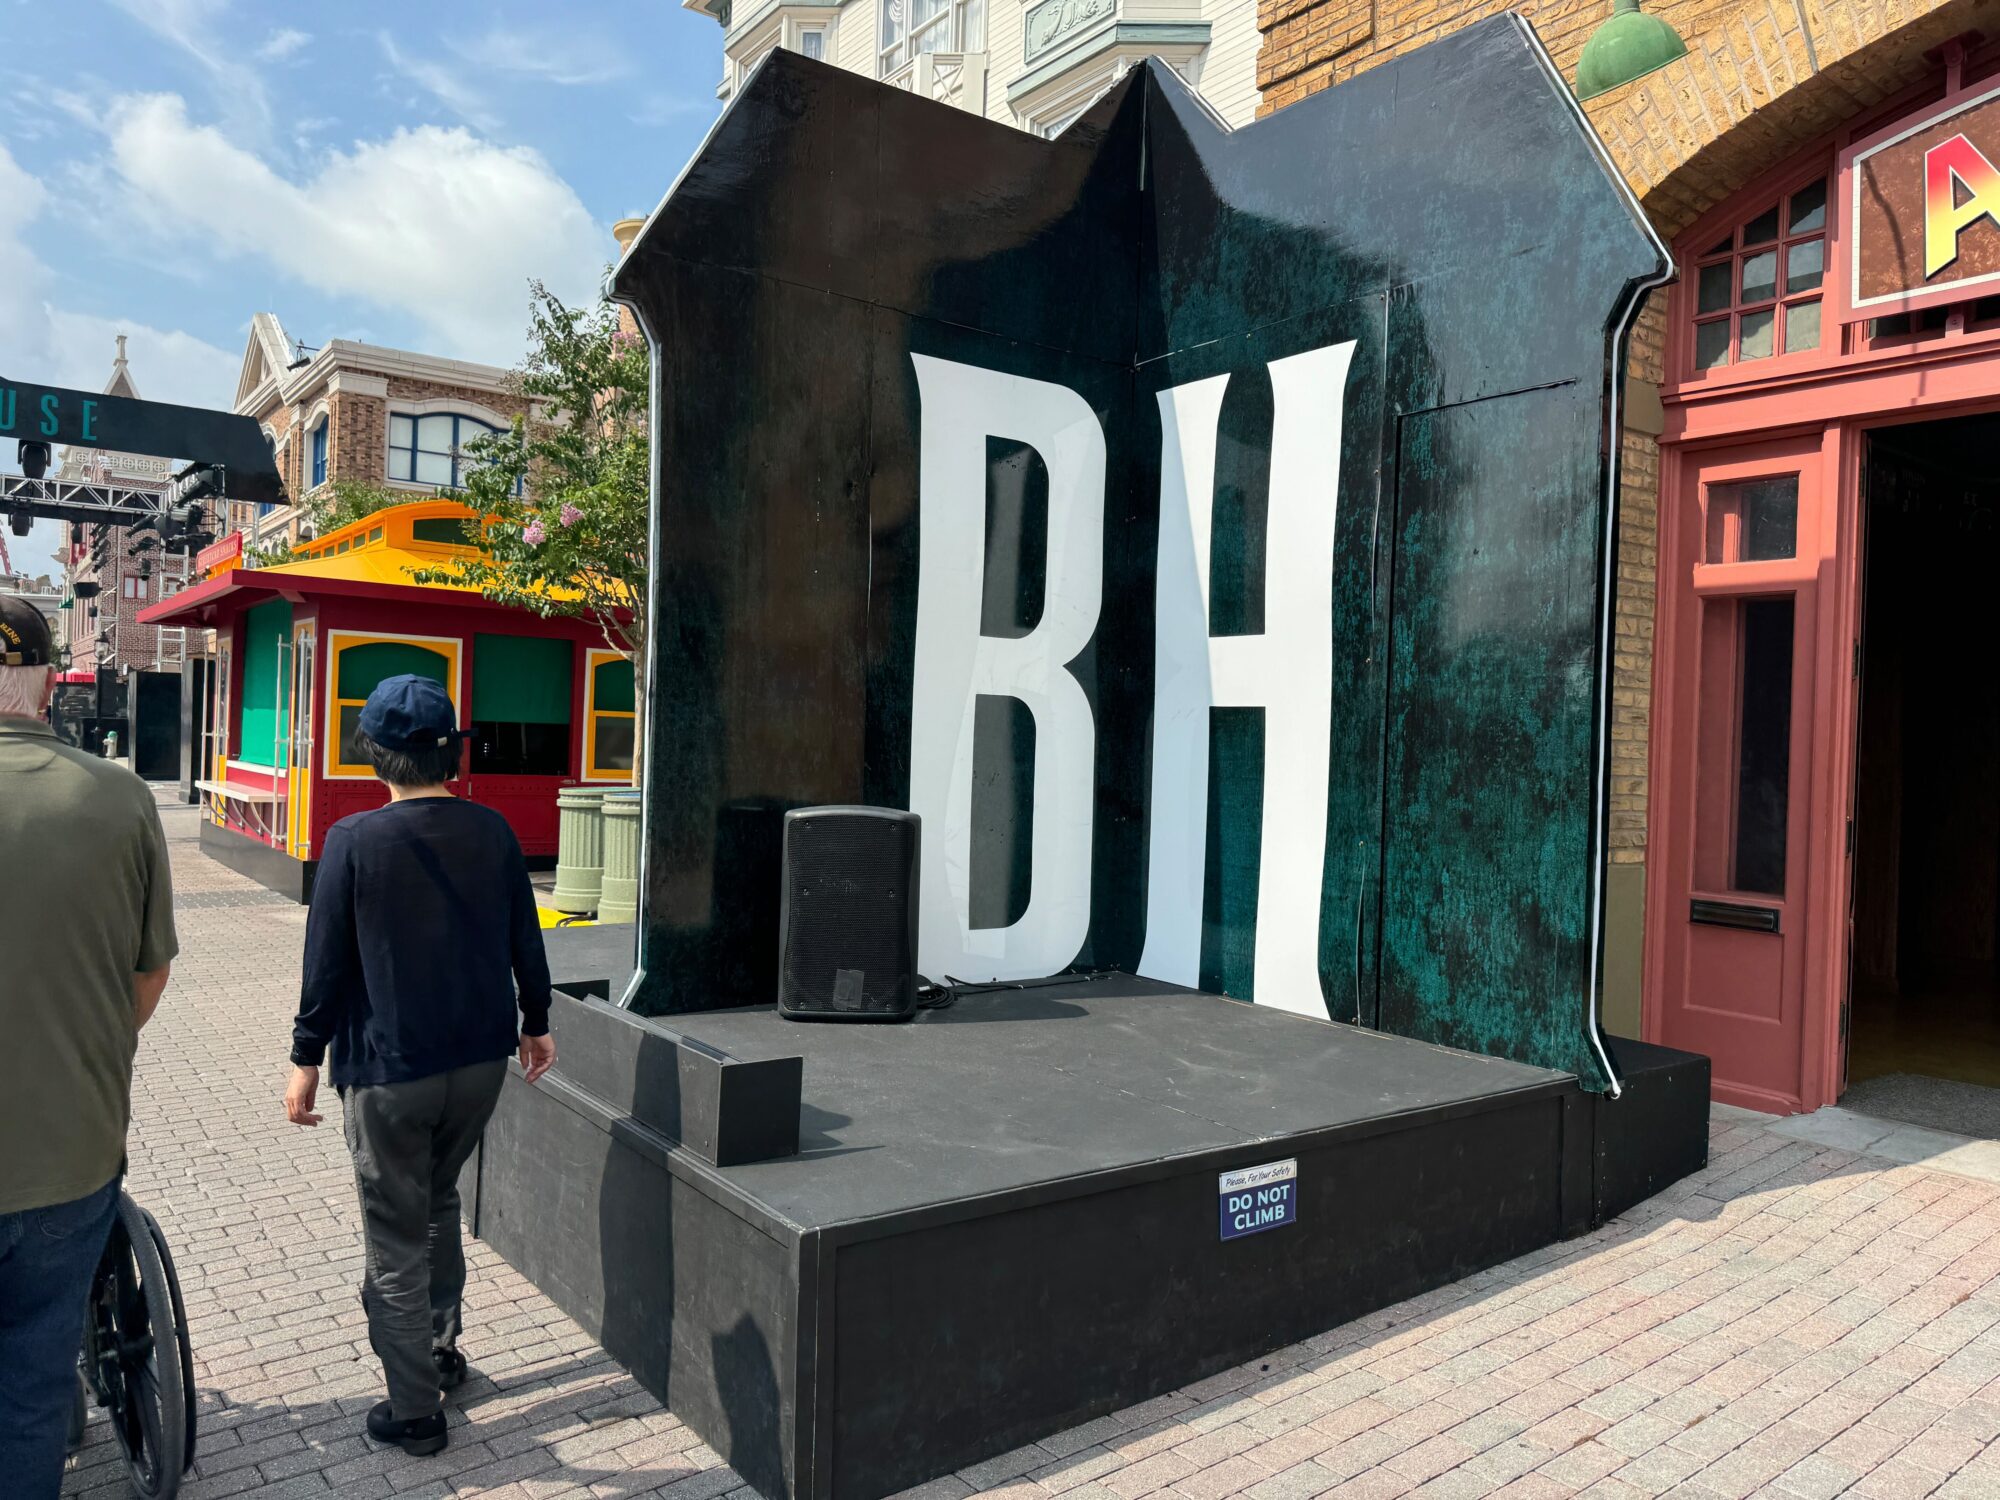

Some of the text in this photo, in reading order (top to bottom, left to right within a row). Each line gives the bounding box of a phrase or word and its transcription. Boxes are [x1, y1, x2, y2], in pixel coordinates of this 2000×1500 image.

[1925, 133, 2000, 281] A
[0, 388, 98, 441] USE
[1248, 1173, 1258, 1182] For
[1259, 1170, 1271, 1180] Your
[1272, 1165, 1291, 1178] Safety
[1229, 1184, 1290, 1213] DO NOT
[1234, 1204, 1285, 1230] CLIMB
